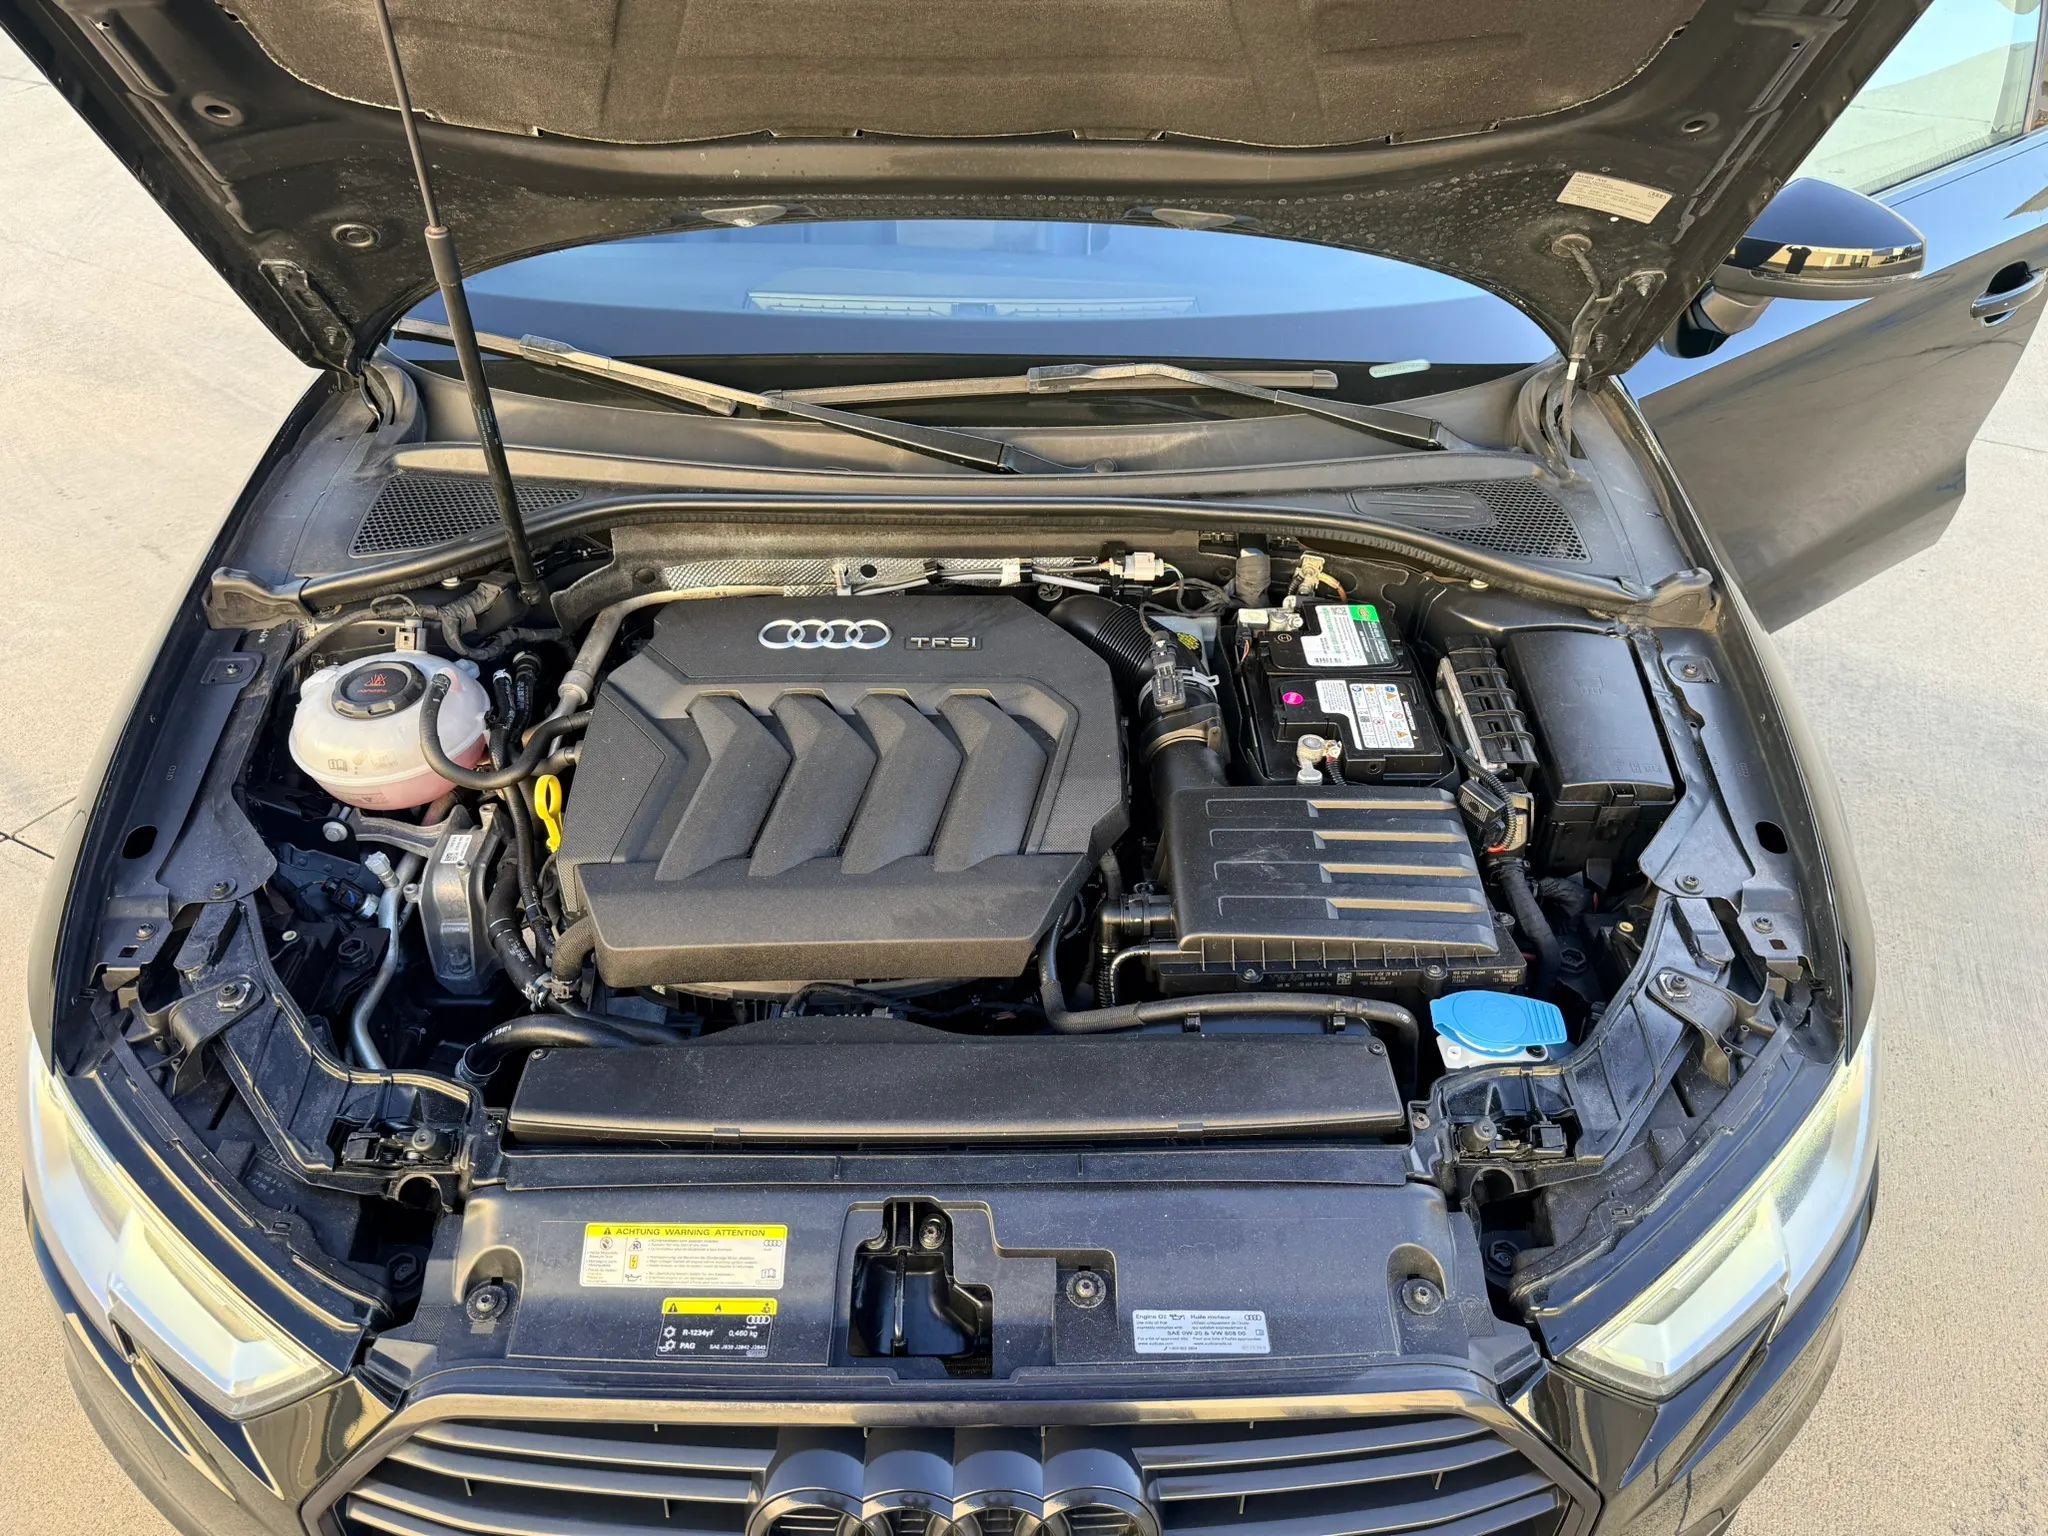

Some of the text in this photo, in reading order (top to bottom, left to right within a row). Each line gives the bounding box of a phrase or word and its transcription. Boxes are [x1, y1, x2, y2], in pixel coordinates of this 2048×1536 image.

[910, 637, 977, 649] TFSI
[616, 1228, 660, 1236] ACHTUNG
[714, 1229, 766, 1237] ATTENTION
[682, 1329, 714, 1337] R-1234yf
[749, 1330, 758, 1338] kg
